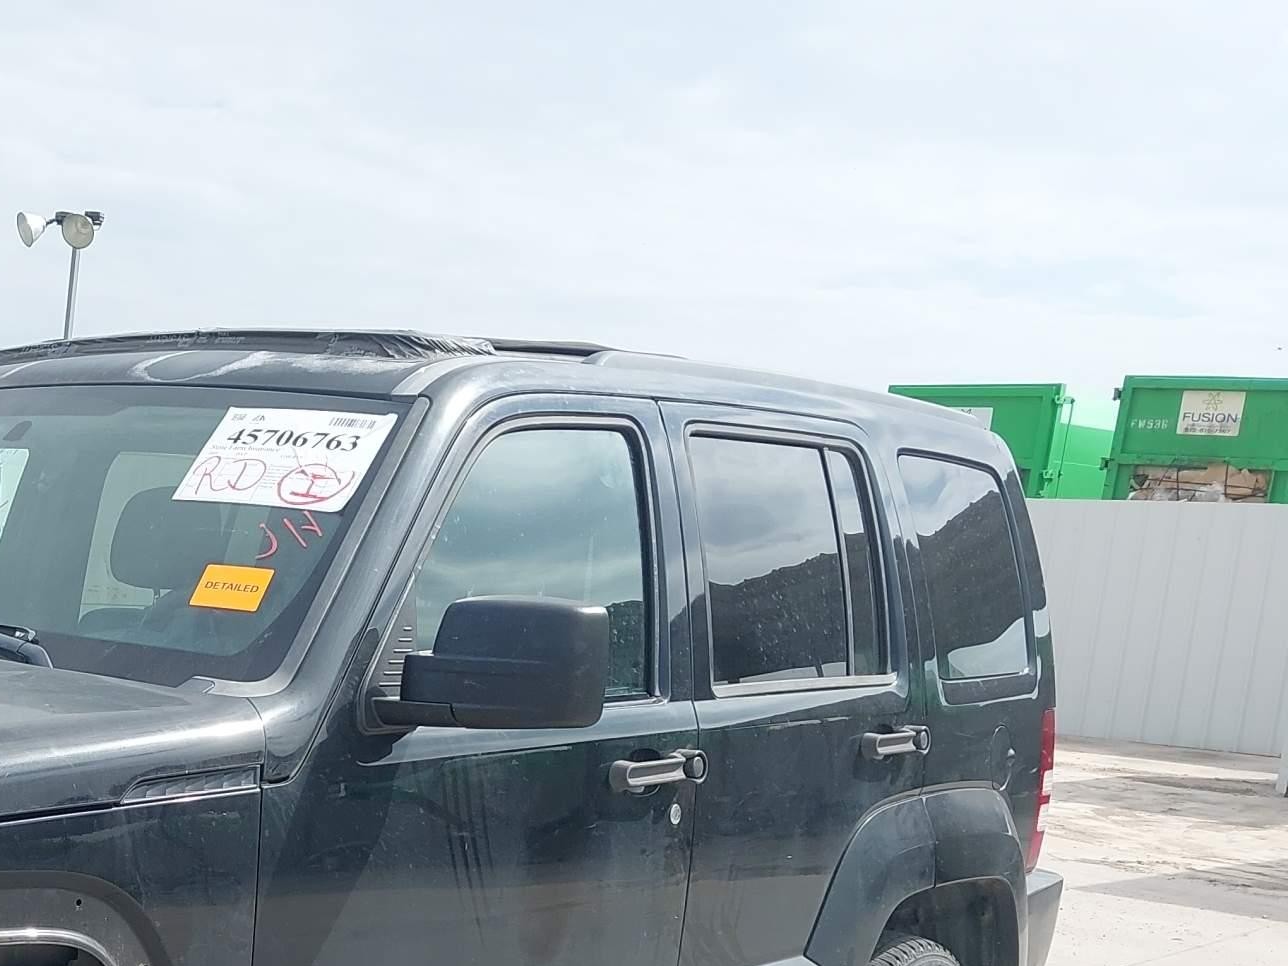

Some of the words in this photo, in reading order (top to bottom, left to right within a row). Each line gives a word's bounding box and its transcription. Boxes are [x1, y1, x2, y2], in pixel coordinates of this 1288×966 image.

[1182, 412, 1239, 423] FUSION
[227, 429, 362, 452] 45706763
[204, 580, 260, 593] DETAILED
